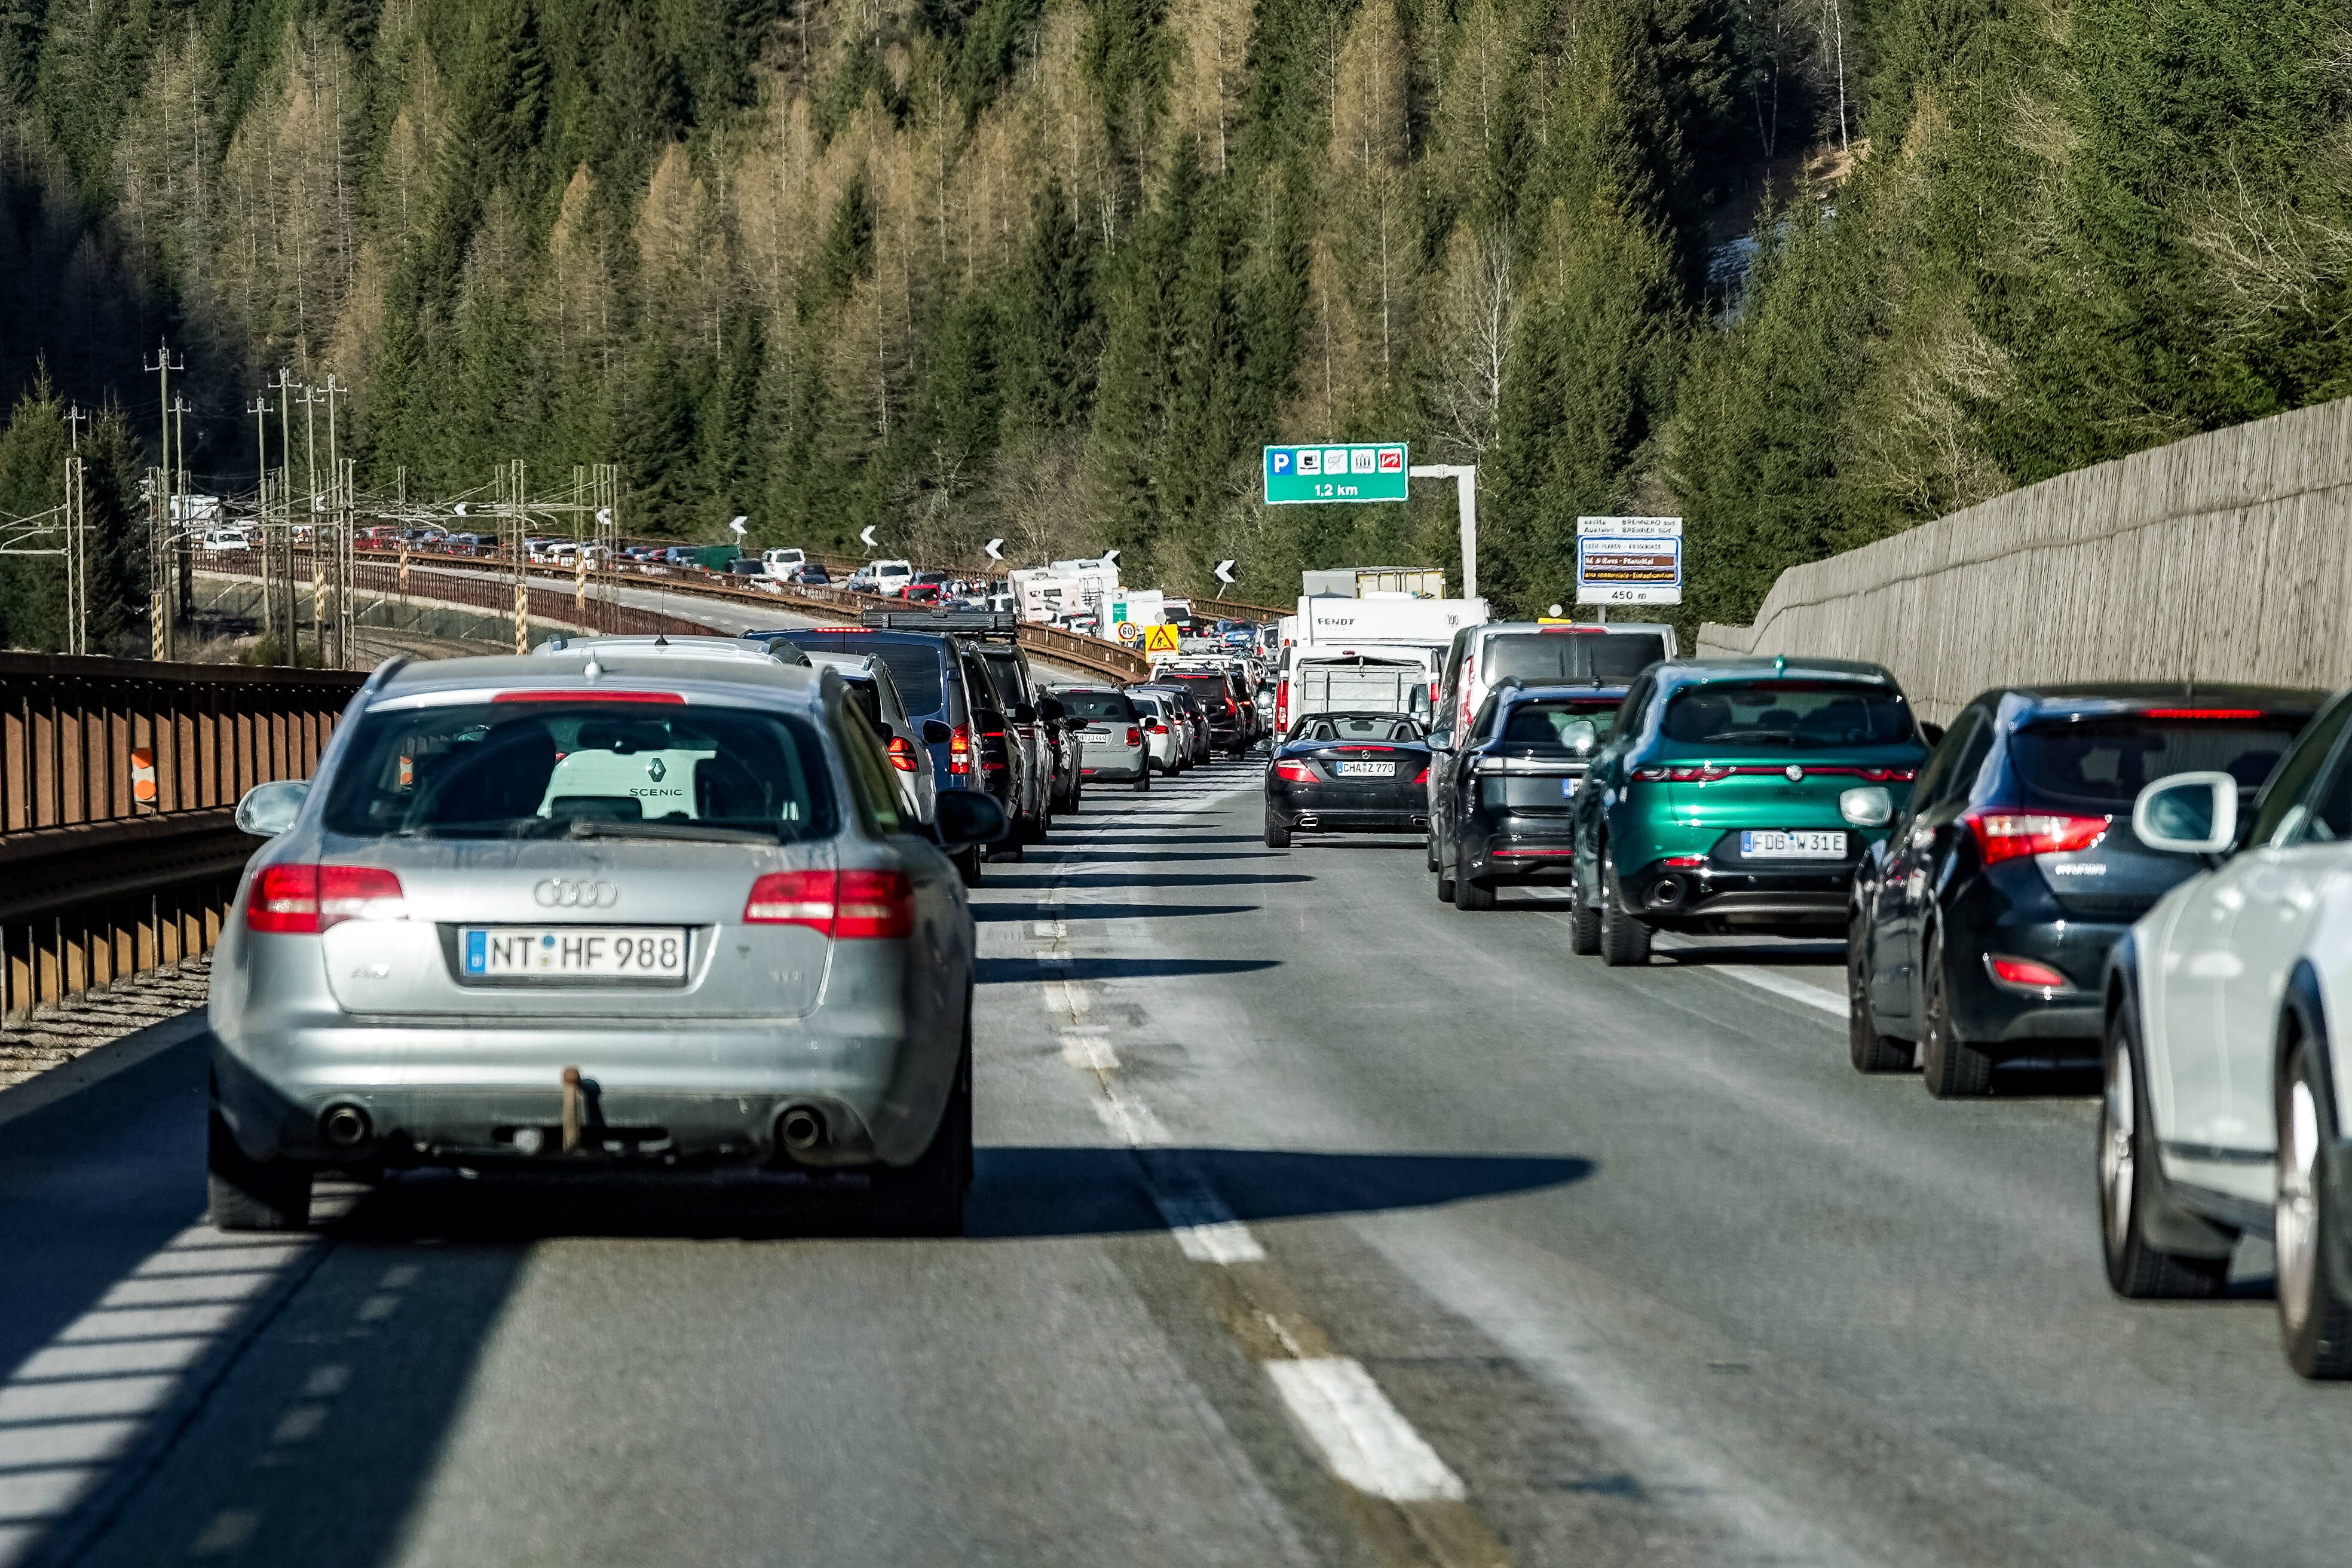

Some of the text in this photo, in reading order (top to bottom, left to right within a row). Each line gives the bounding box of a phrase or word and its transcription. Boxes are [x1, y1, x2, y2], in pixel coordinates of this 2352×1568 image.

[1337, 484, 1358, 496] km
[1612, 591, 1633, 599] 450
[1122, 627, 1132, 635] 60
[1376, 764, 1394, 772] 770
[492, 937, 535, 967] NT
[561, 936, 605, 969] HF
[614, 937, 677, 970] 988
